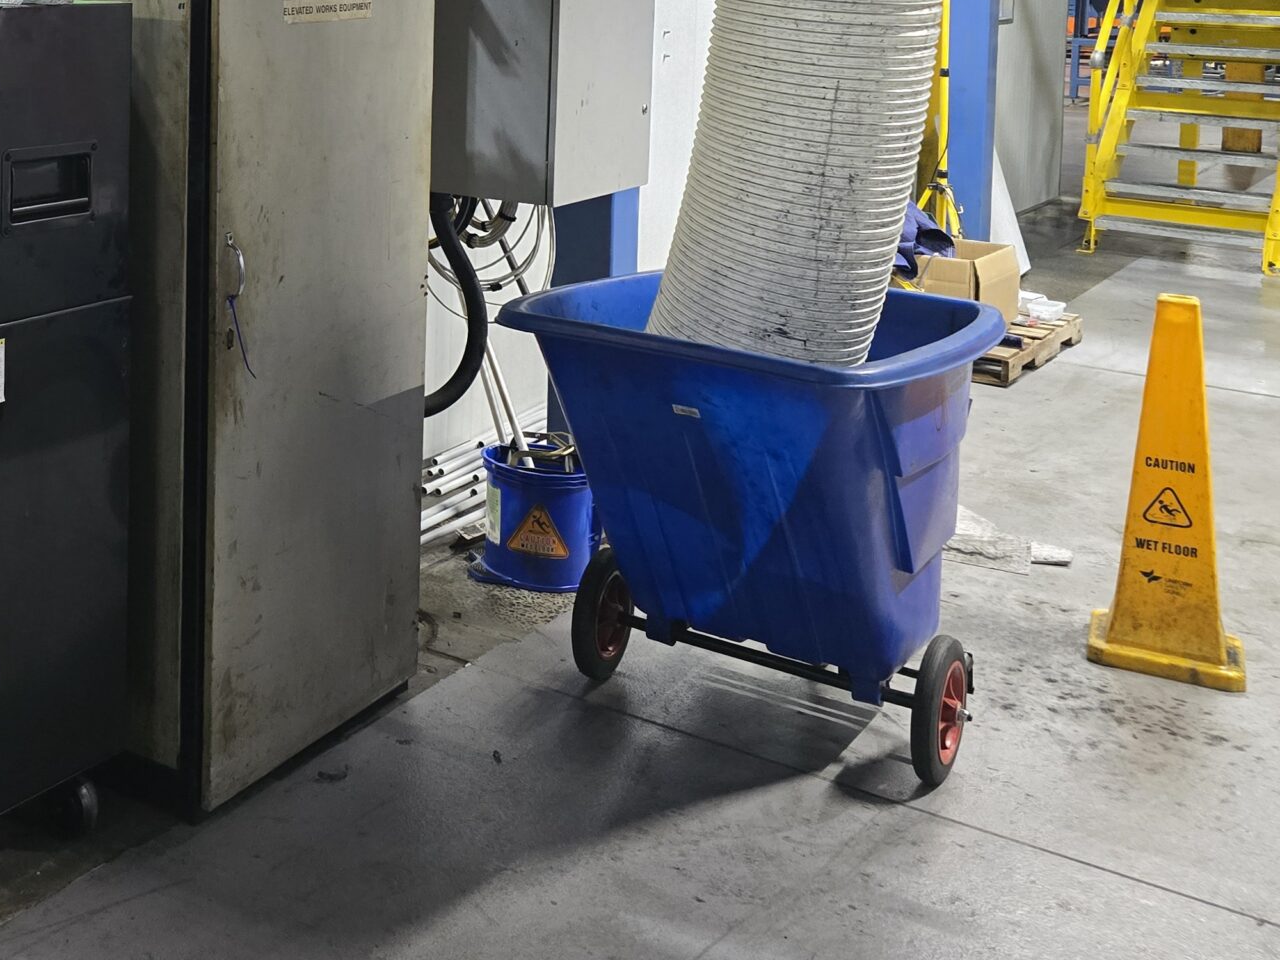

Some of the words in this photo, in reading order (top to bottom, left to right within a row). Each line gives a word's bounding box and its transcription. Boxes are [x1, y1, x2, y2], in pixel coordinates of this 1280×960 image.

[283, 5, 314, 16] ELEVATED
[315, 4, 338, 14] WORKS
[339, 1, 372, 12] EQUIPMENT
[1145, 456, 1195, 474] CAUTION
[1135, 537, 1159, 552] WET
[1161, 542, 1198, 558] FLOOR
